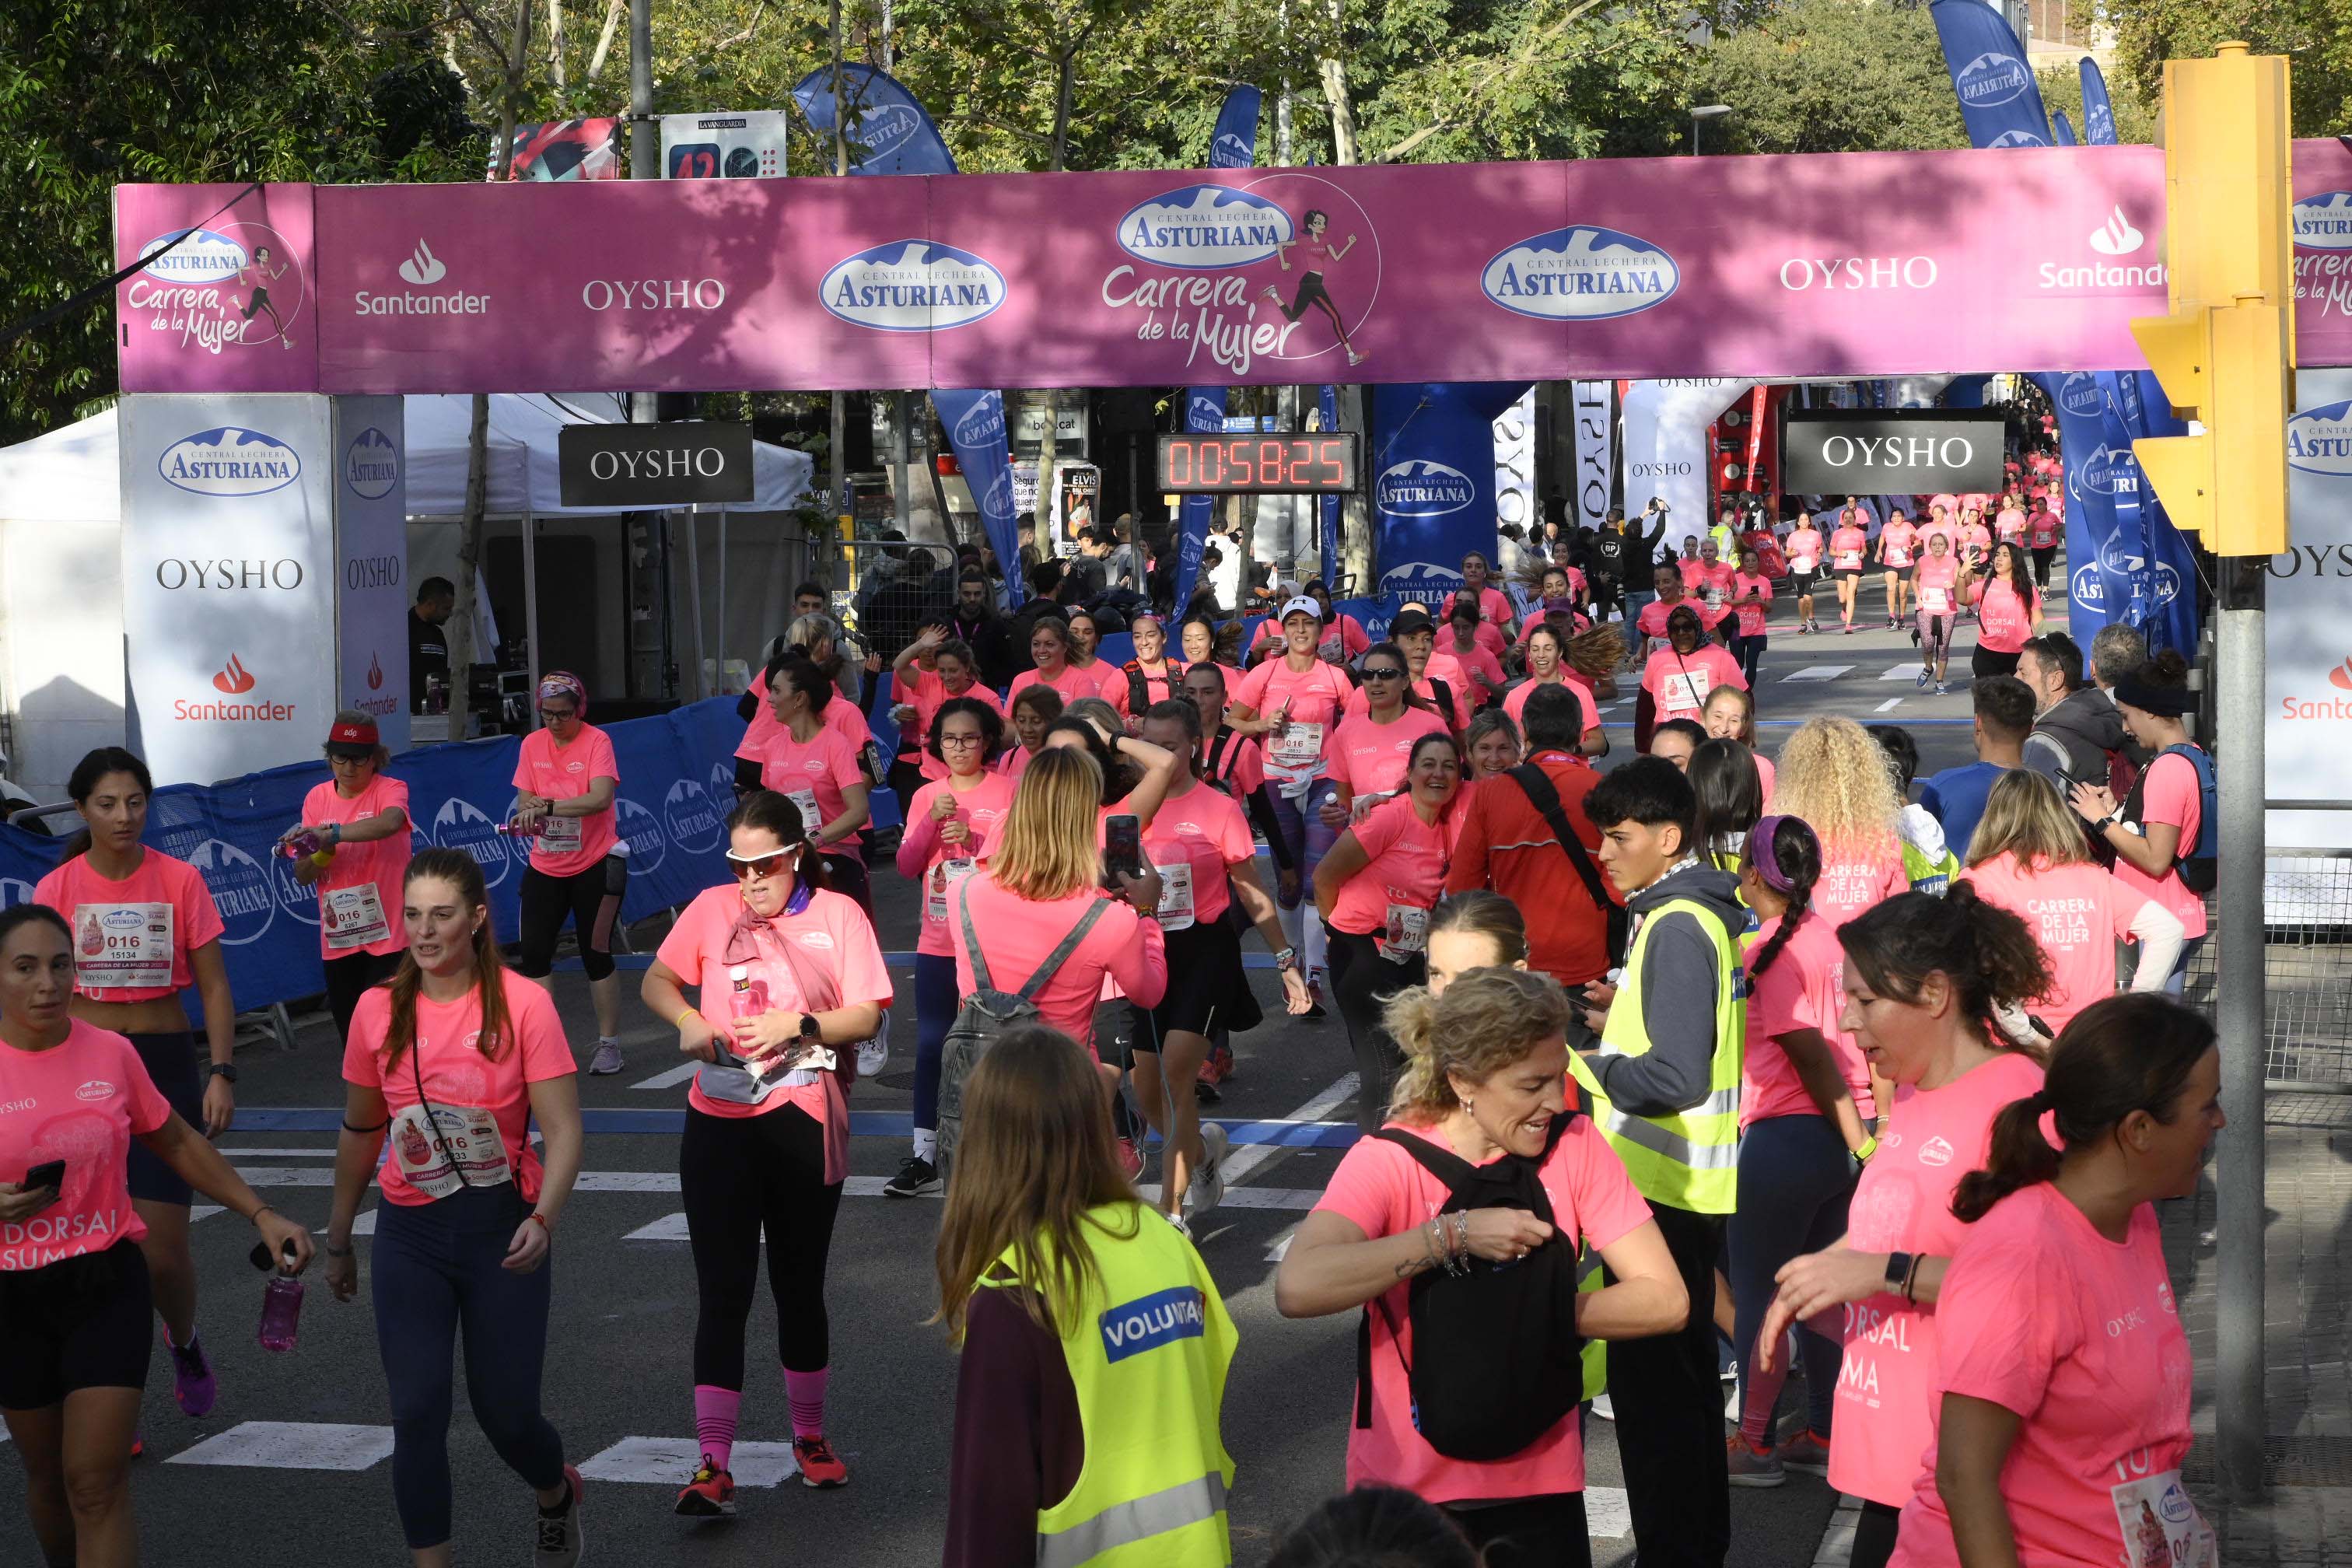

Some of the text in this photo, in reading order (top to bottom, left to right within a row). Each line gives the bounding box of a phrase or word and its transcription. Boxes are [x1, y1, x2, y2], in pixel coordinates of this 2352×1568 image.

[1157, 212, 1275, 222] CENTRAL LECHERA
[1130, 216, 1280, 249] ASTURIANA
[863, 269, 986, 282] CENTRAL LECHERA
[1528, 257, 1657, 269] CENTRAL LECHERA
[1780, 256, 1938, 291] OYSHO
[2039, 262, 2168, 289] Santand
[834, 274, 992, 309] ASTURIANA
[1101, 264, 1248, 308] Carrera
[1496, 263, 1664, 297] ASTURIANA
[128, 280, 219, 309] Carrera
[355, 290, 491, 316] Santander
[583, 278, 726, 312] OYSHO
[151, 306, 254, 355] de la Mujer
[1138, 300, 1303, 376] de la Mujer
[590, 446, 724, 481] OYSHO
[1170, 441, 1343, 485] 00:58:25
[1822, 436, 1973, 468] OYSHO
[170, 453, 290, 479] ASTURIANA
[350, 453, 395, 481] ASTURIANA
[1632, 461, 1692, 478] OYSHO
[1015, 498, 1039, 507] quiere
[1380, 482, 1468, 504] ASTURIANA
[156, 558, 303, 590] OYSHO
[348, 555, 400, 590] OYSHO
[2266, 544, 2352, 578] OYS
[174, 699, 296, 722] Santander
[2283, 696, 2352, 720] Santa
[344, 728, 358, 738] edp
[1830, 877, 1867, 891] DE LA
[212, 884, 271, 918] TURIANA
[1826, 891, 1869, 905] MUJER
[2027, 899, 2095, 915] CARRERA
[338, 910, 360, 922] 016
[2041, 913, 2086, 929] DE LA
[107, 936, 140, 948] 016
[2042, 929, 2089, 944] MUJER
[79, 1087, 114, 1099] ASTURIANA
[426, 1118, 463, 1129] ATURIANA
[432, 1136, 468, 1153] 016
[416, 1168, 444, 1180] CARRERA
[471, 1170, 505, 1181] Santander
[1844, 1300, 1911, 1352] RSAL
[1840, 1350, 1879, 1395] MA
